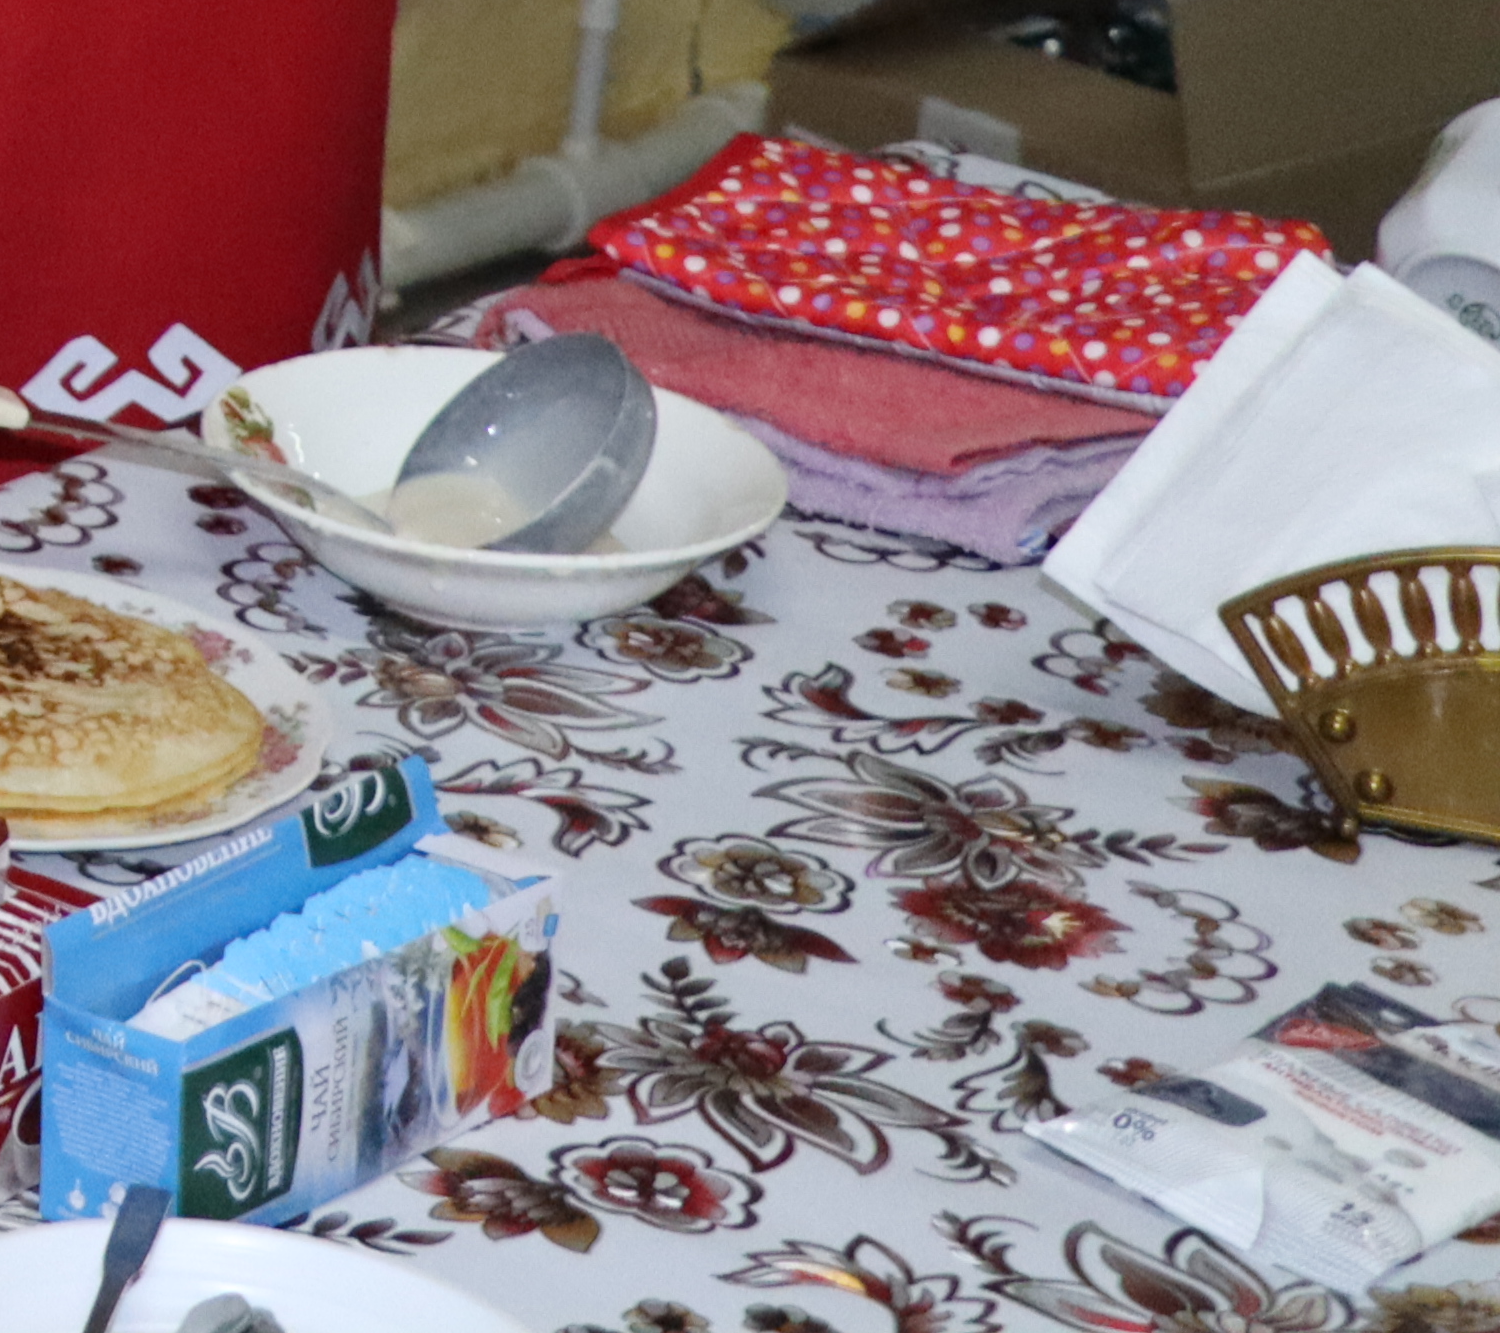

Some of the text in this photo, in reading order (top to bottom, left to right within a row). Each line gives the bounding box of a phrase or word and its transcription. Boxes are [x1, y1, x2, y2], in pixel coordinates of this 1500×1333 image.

[266, 1045, 288, 1191] ВДОХНОВЕНИЕ
[310, 1064, 330, 1131] ЧАЙ
[327, 1016, 348, 1163] СИБИРСКИЙ
